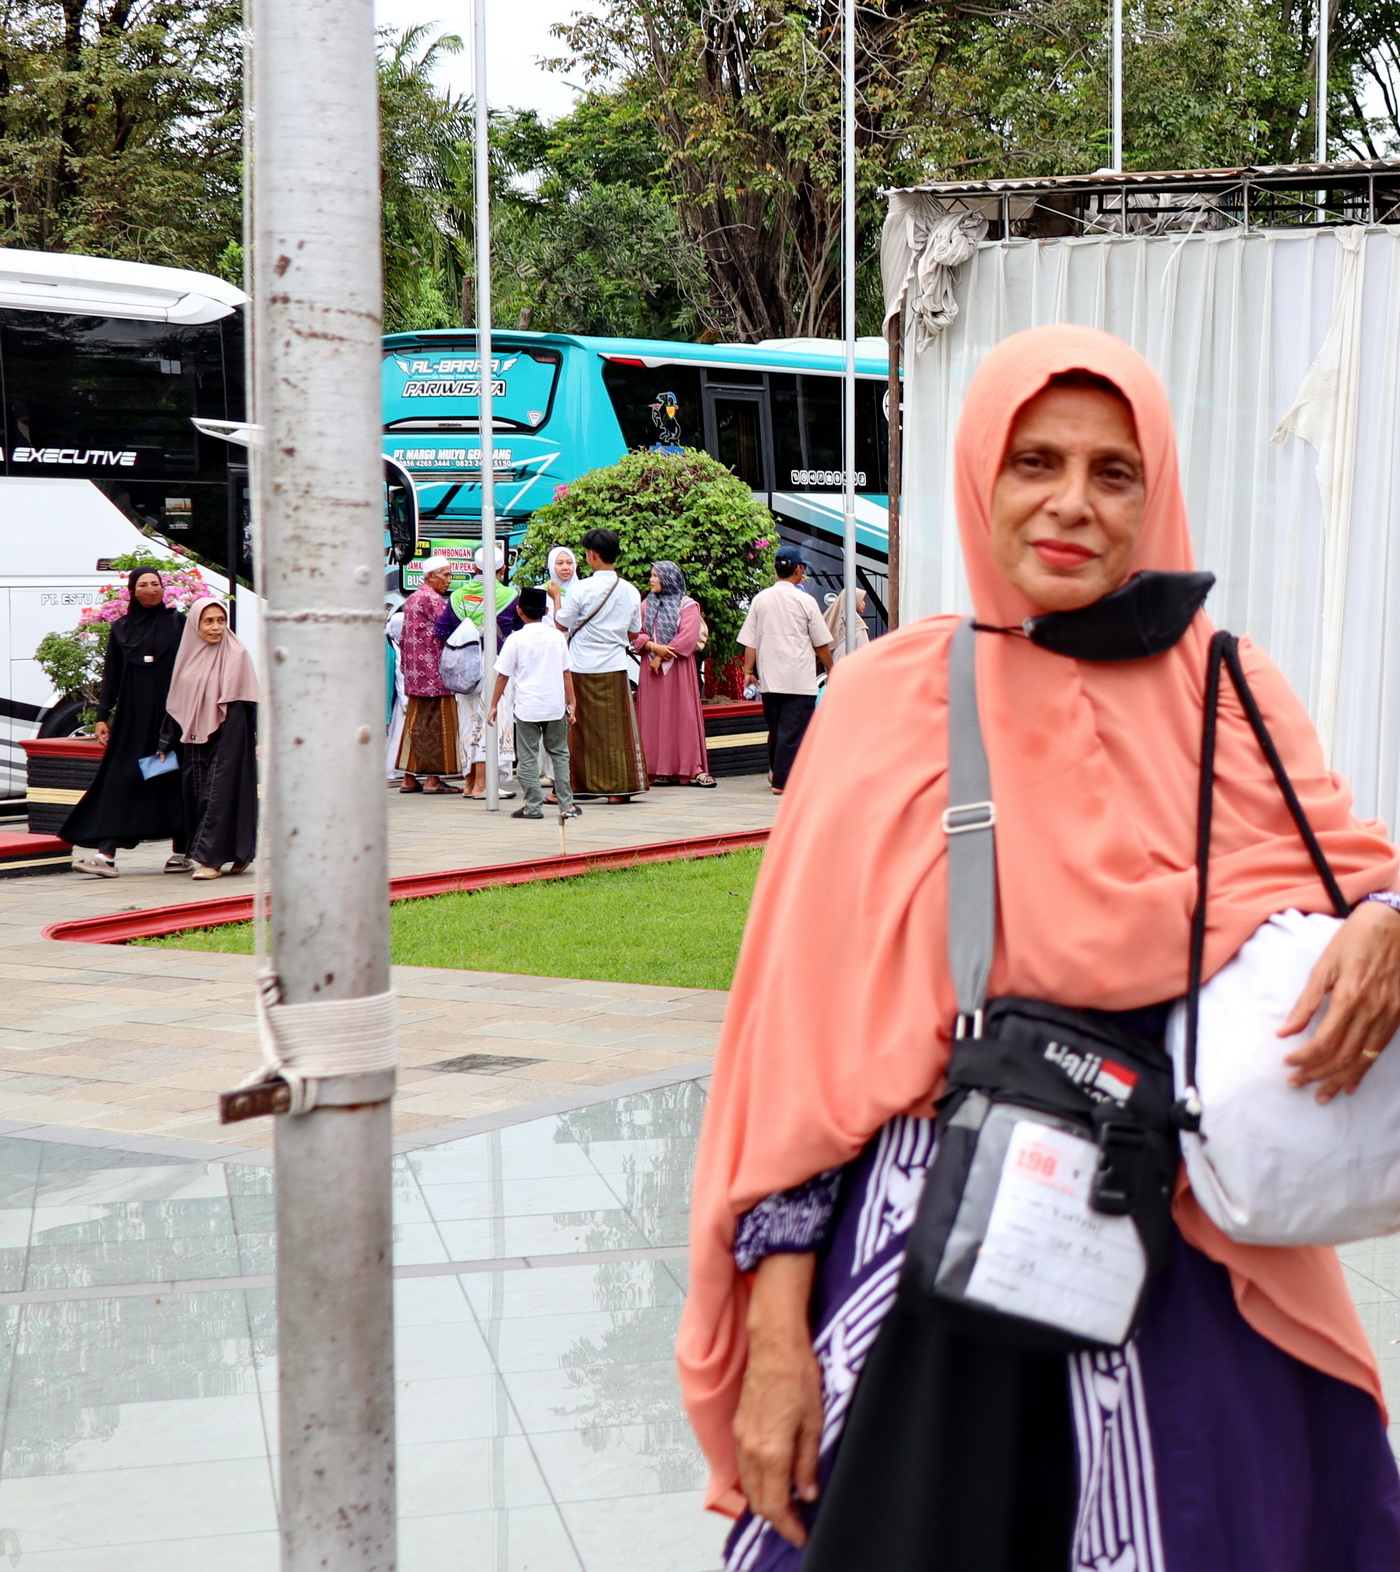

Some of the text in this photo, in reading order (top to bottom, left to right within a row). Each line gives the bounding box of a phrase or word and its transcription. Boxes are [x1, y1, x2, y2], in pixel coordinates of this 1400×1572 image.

[12, 447, 137, 467] EXECUTIVE
[405, 449, 436, 460] MARGO
[437, 449, 466, 460] MULYO
[467, 449, 512, 460] GEANG
[433, 548, 471, 558] ROMBONGAN
[407, 575, 425, 586] BUS
[41, 594, 59, 605] PT.
[61, 594, 93, 605] ESTU
